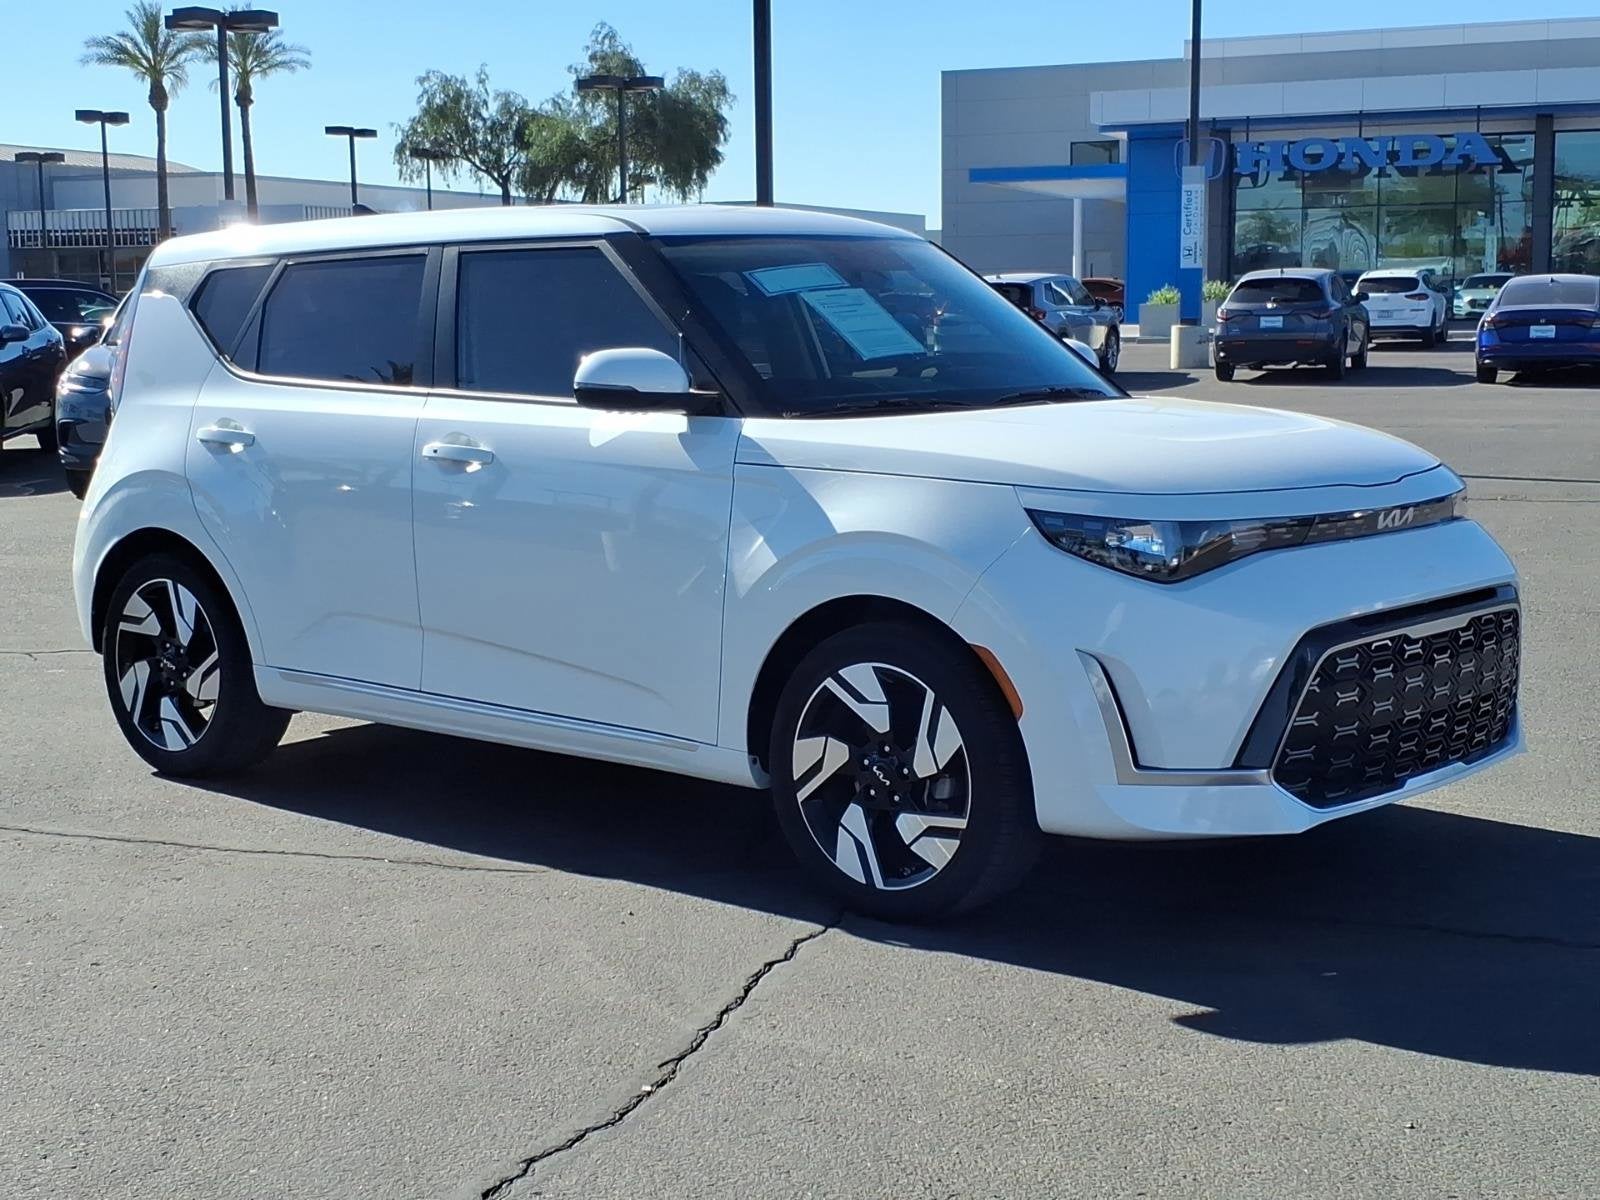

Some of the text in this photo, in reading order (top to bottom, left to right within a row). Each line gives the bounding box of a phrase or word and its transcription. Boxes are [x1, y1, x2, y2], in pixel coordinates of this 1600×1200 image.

[1233, 132, 1502, 174] HONDA
[1183, 190, 1193, 236] Certified
[1377, 507, 1415, 529] KIA
